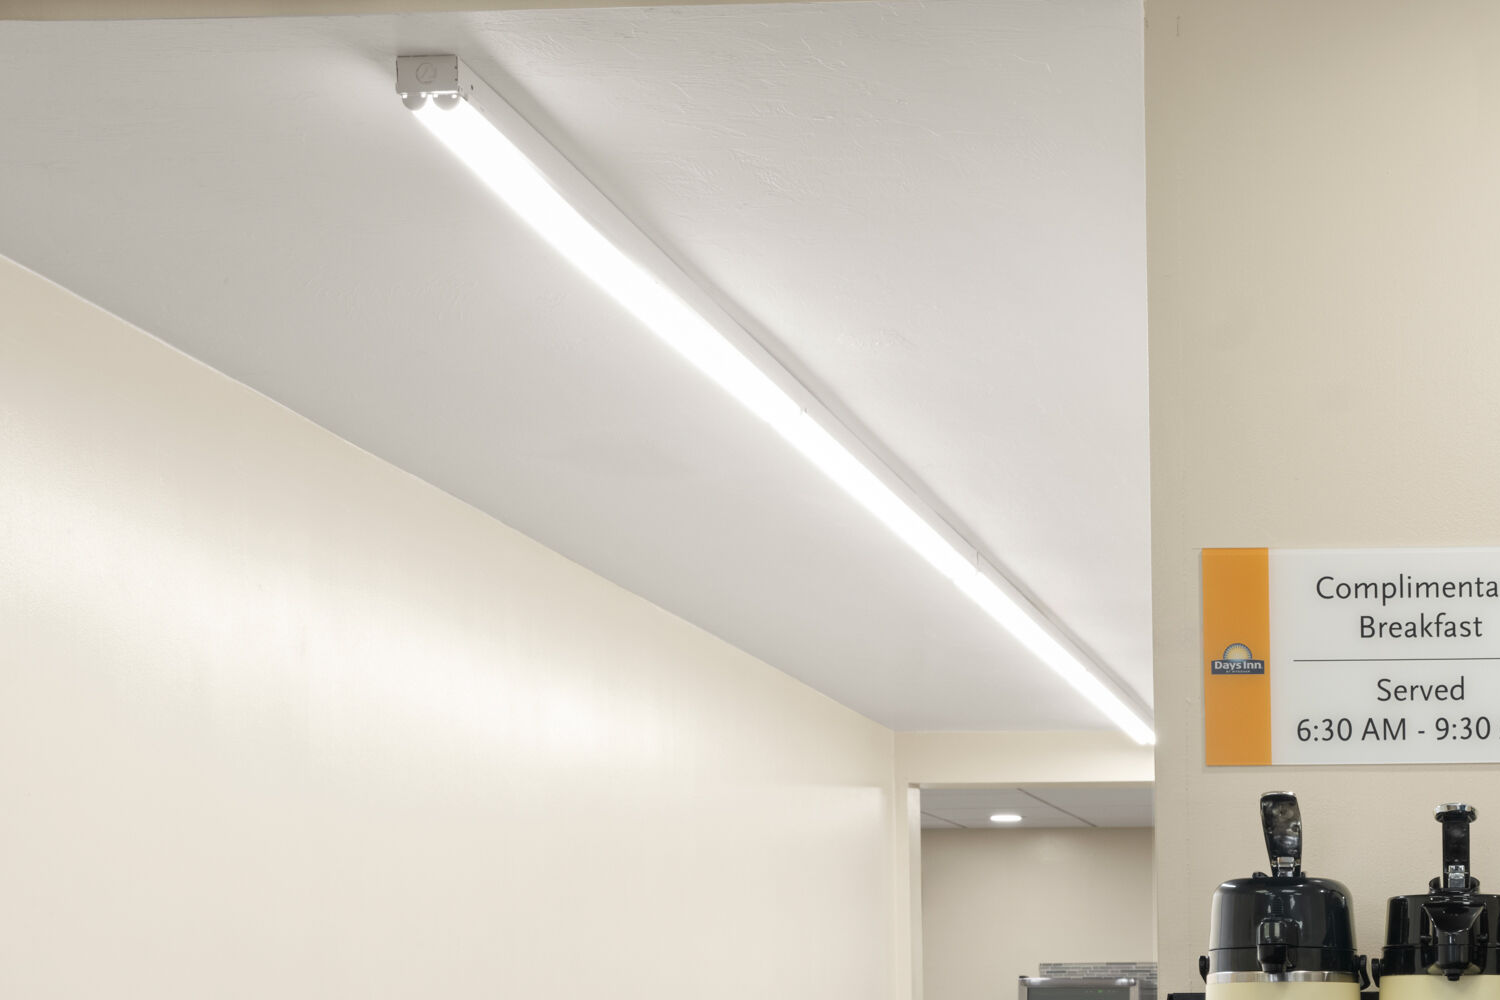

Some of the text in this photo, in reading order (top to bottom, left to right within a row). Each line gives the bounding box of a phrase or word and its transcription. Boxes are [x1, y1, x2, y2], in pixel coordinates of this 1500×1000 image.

[1359, 612, 1483, 639] Breakfast
[1214, 660, 1262, 671] Days Inn
[1376, 675, 1465, 702] Served
[1296, 717, 1353, 742] 6:30
[1361, 717, 1407, 741] AM
[1435, 716, 1491, 740] 9:30
